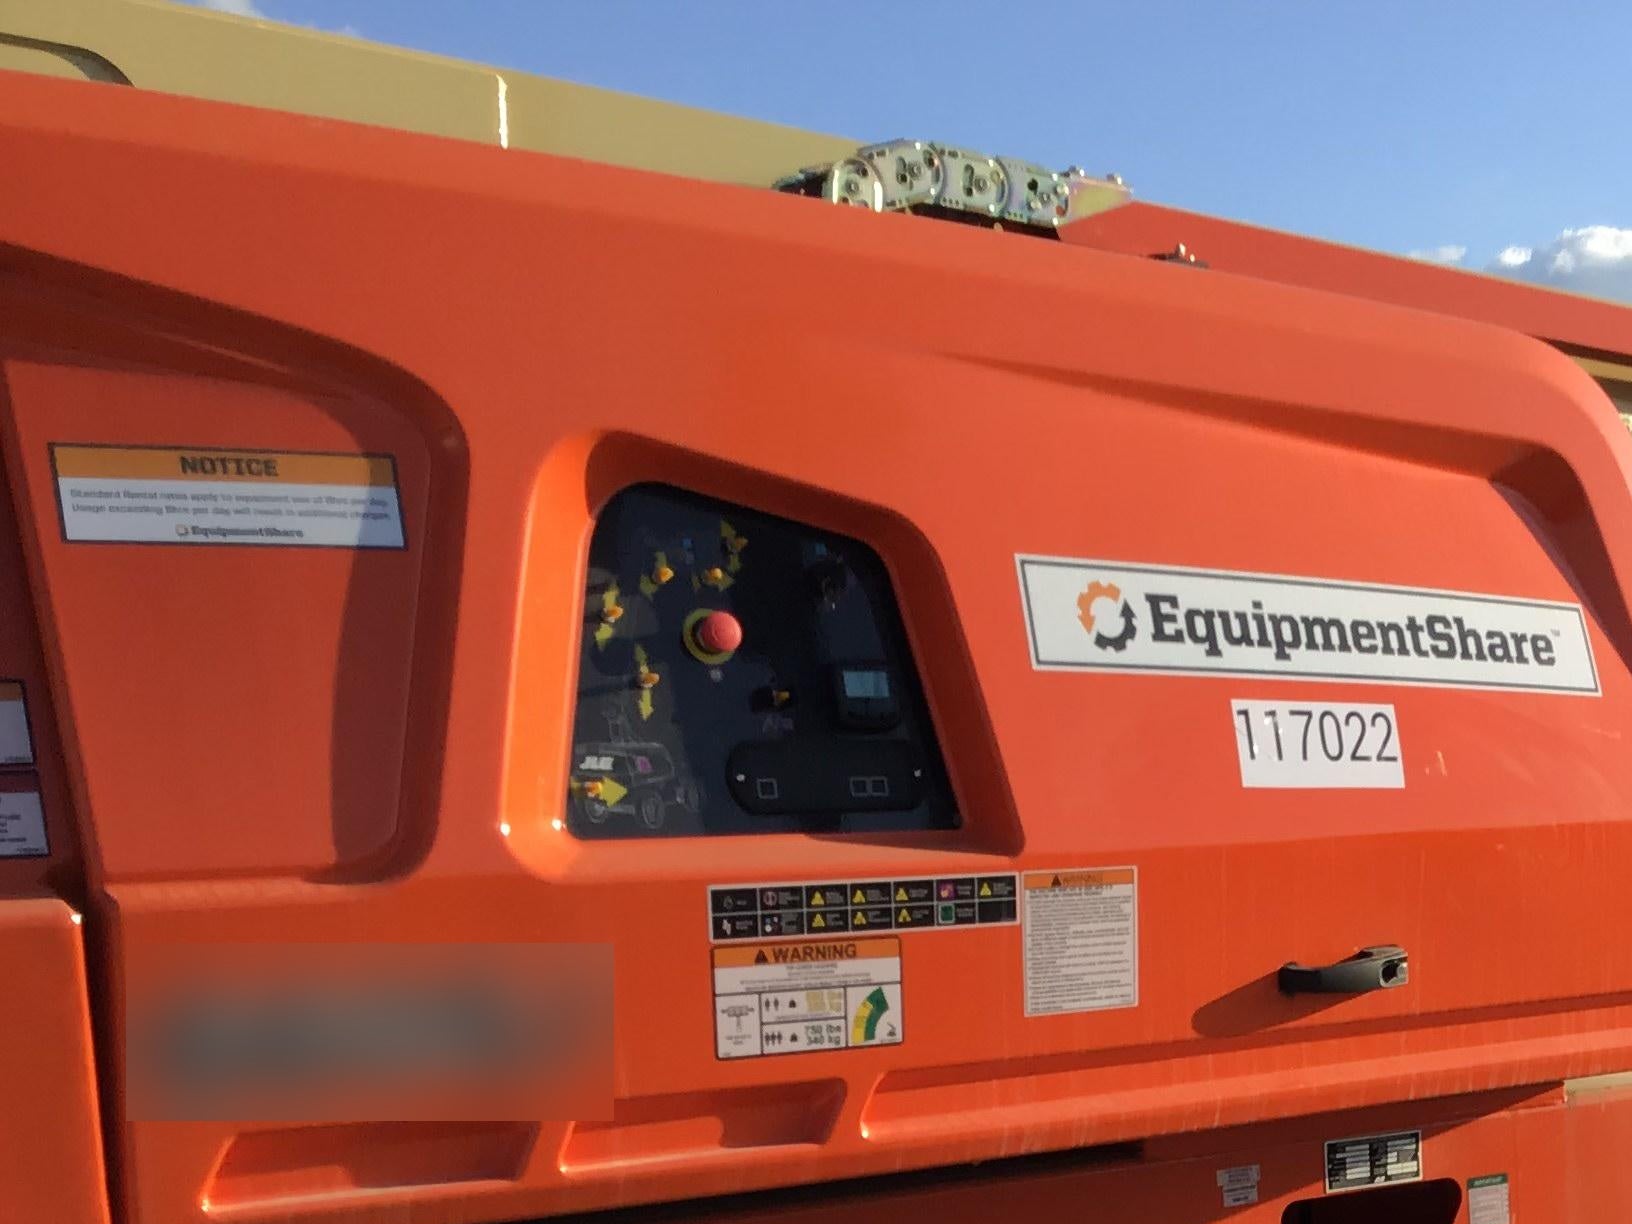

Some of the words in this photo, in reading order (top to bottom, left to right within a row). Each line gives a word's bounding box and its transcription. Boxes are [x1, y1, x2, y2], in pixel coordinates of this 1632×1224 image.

[180, 455, 278, 477] NOTICE
[1143, 592, 1556, 667] EquipmentShare
[1235, 708, 1397, 763] 117022
[772, 944, 858, 963] WARNING
